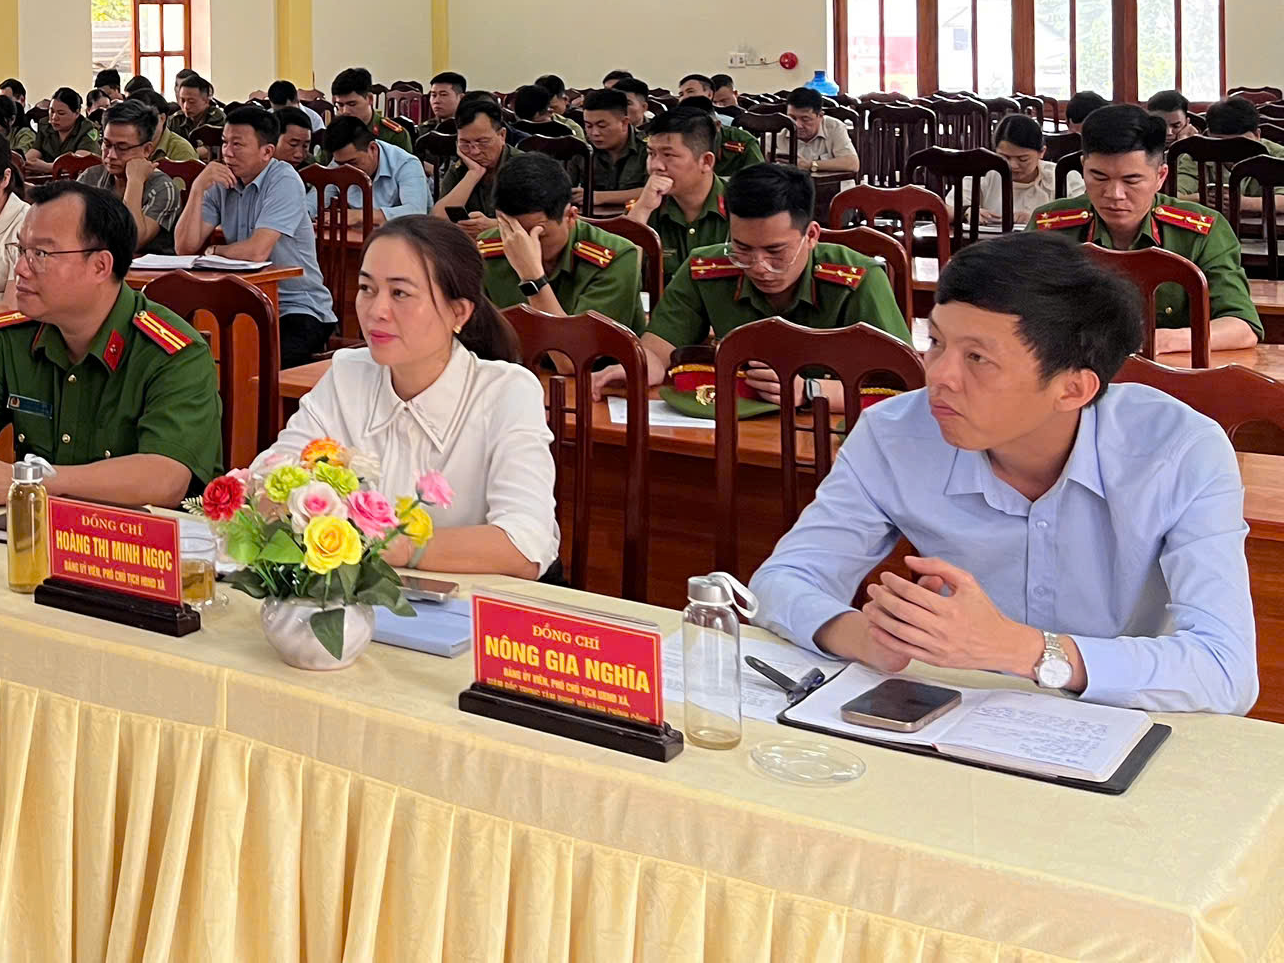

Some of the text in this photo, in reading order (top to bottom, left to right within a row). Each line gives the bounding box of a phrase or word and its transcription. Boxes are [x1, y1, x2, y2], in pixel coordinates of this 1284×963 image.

[81, 513, 143, 536] ĐỒNG CHÍ
[55, 529, 173, 574] HOÀNG THỊ MINH NGỌC
[532, 623, 600, 651] ĐỒNG CHÍ
[484, 635, 540, 667] NÔNG
[545, 648, 580, 677] GIA
[585, 658, 651, 694] NGHĨA
